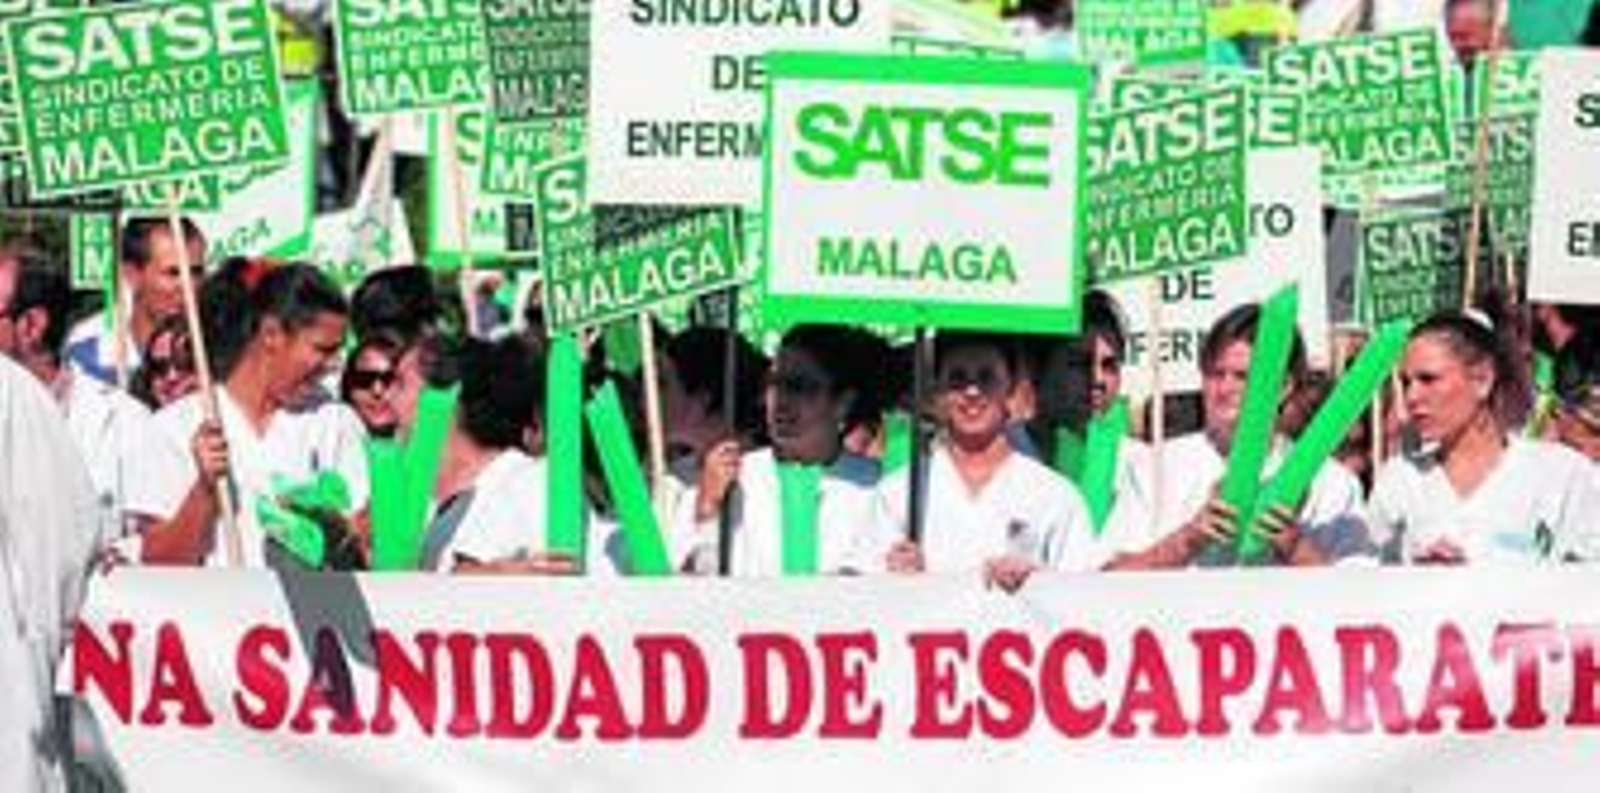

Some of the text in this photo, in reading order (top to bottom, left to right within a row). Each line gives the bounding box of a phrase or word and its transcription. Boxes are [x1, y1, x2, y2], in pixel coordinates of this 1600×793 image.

[25, 0, 264, 80] SATSE
[629, 0, 861, 27] SINDICATO
[32, 57, 268, 111] SINDICATO DE
[711, 54, 764, 90] DE
[1272, 35, 1435, 94] SATSE
[35, 87, 270, 139] ENFERMERIA
[40, 116, 277, 187] MALAGA
[793, 102, 1053, 188] SATSE
[552, 240, 727, 324] MALAGA
[817, 235, 1017, 284] MALAGA
[1159, 269, 1214, 303] DE
[233, 622, 712, 741] SANIDAD
[738, 629, 883, 741] DE
